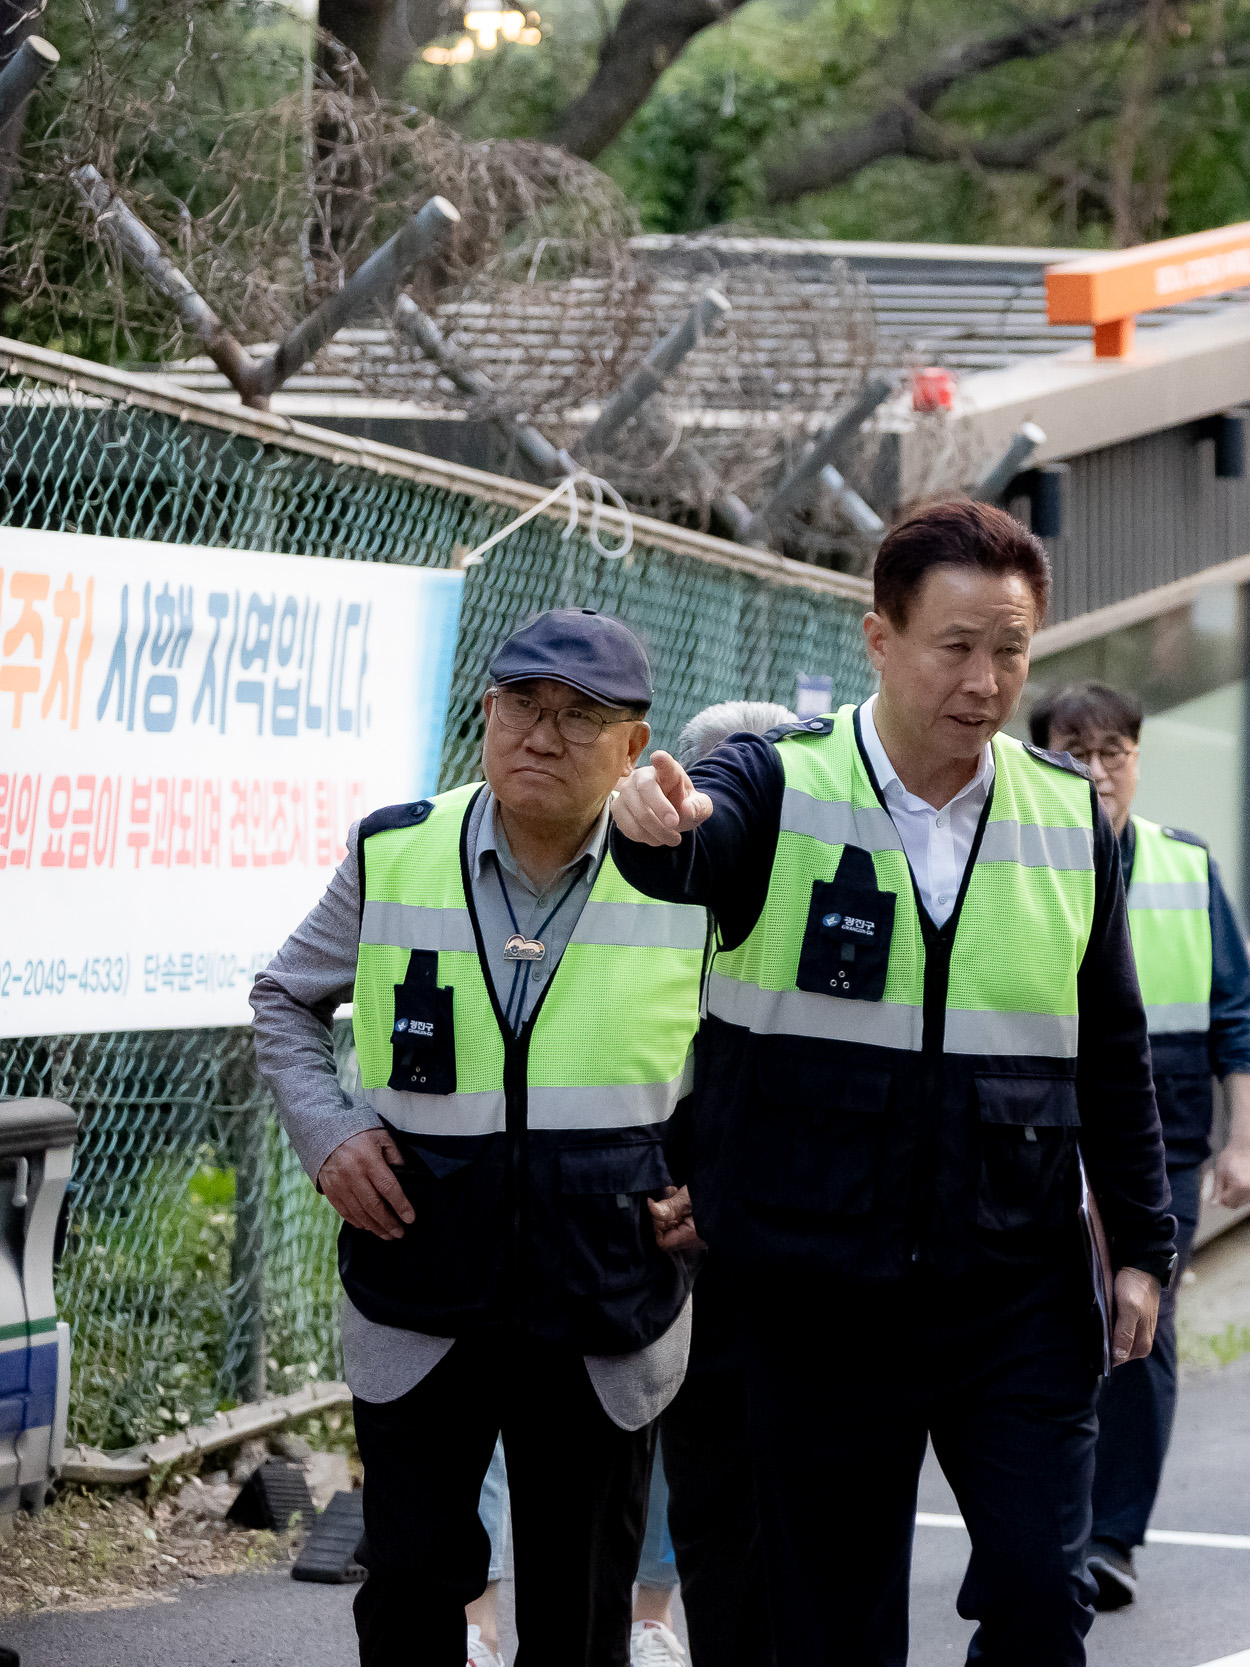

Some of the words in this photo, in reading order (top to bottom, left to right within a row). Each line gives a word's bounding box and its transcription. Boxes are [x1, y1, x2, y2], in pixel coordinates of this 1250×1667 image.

[0, 566, 95, 731] 주차
[96, 580, 193, 733] 시행
[193, 587, 372, 739] 지역입니다.
[41, 774, 122, 869] 요금이
[127, 775, 222, 869] 부과되며
[229, 777, 308, 869] 견인조치
[843, 916, 875, 930] 광진구
[0, 952, 130, 997] 2-2049-4533)
[409, 1019, 434, 1031] 광진구
